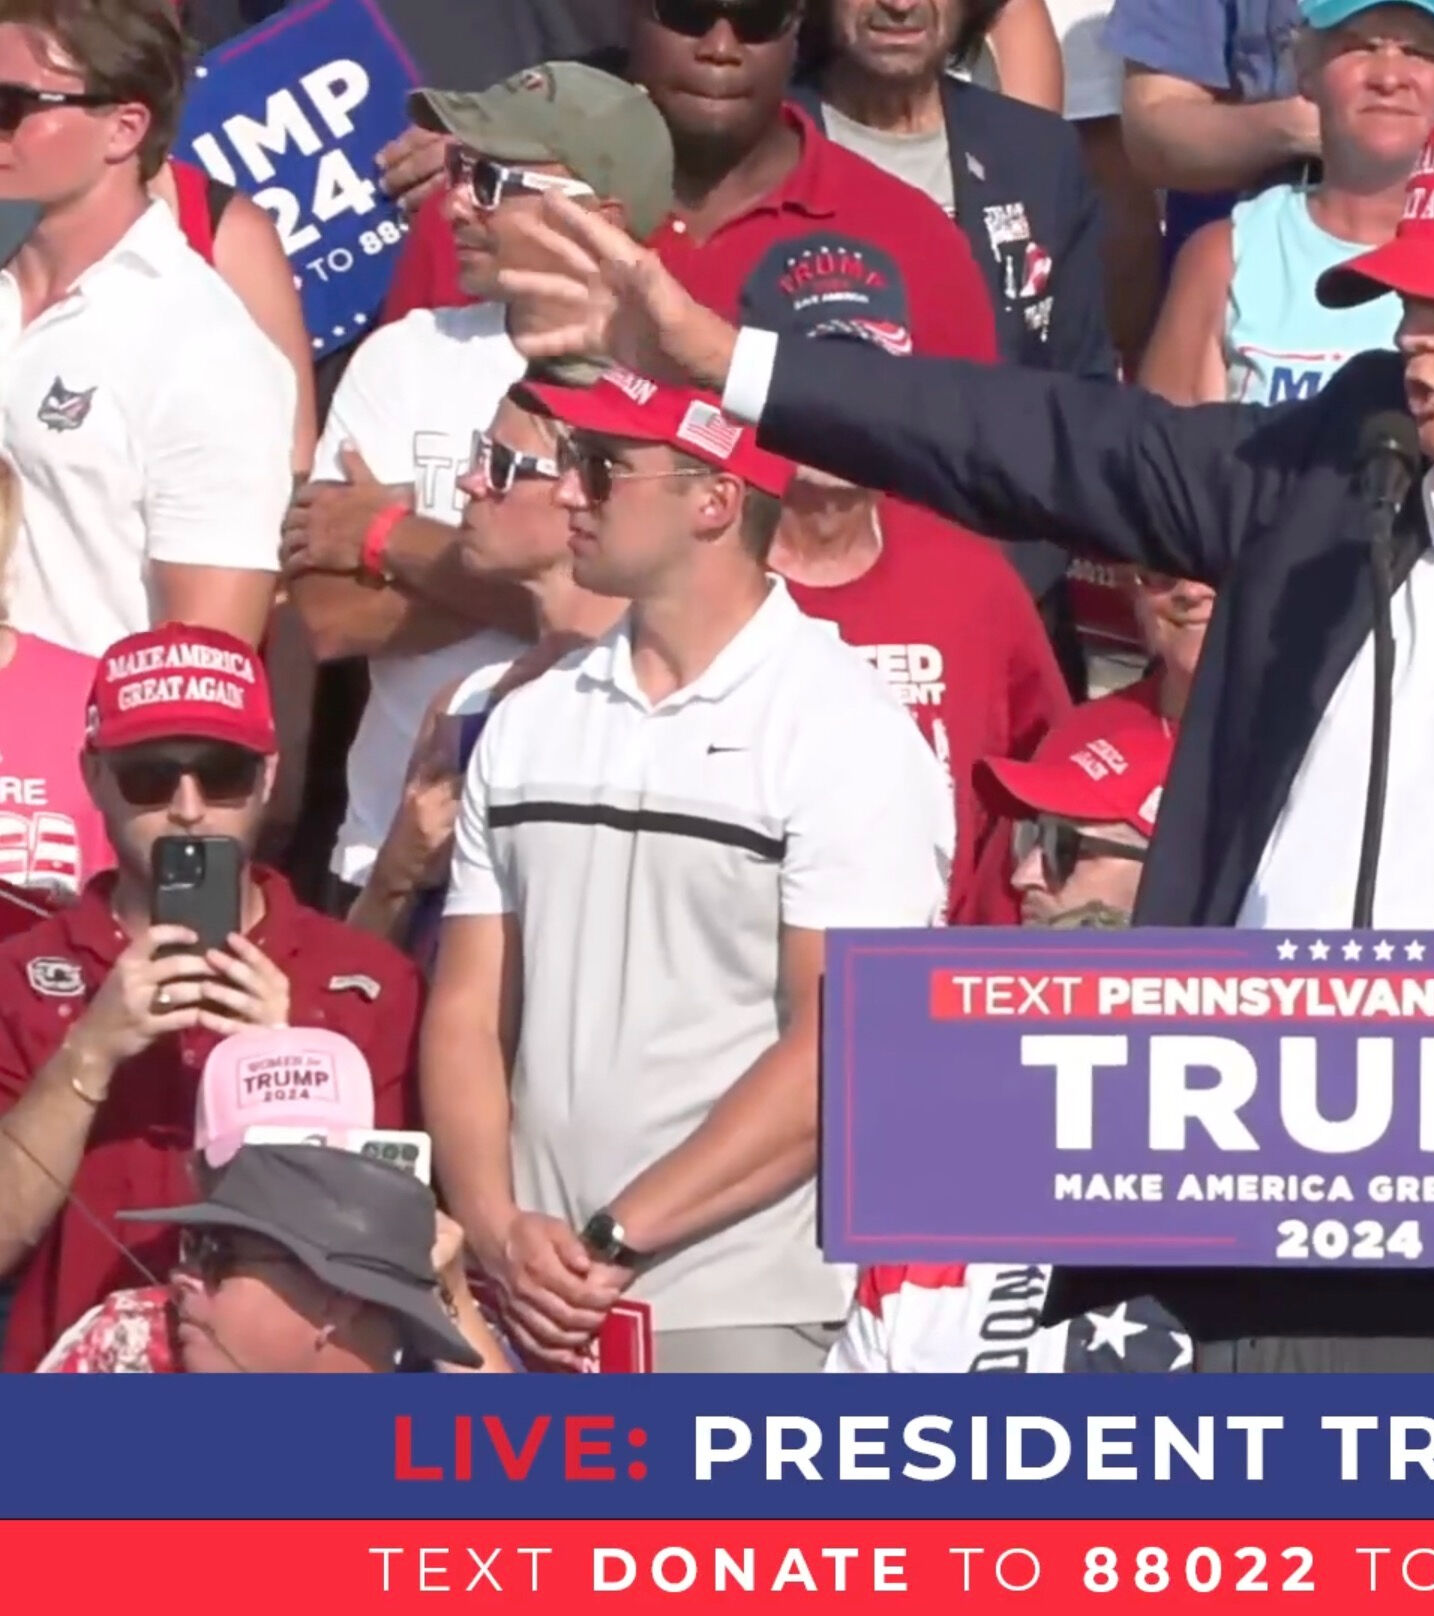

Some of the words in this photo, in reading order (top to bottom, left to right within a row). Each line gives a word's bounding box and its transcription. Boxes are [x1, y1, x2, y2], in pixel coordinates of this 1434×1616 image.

[306, 247, 353, 282] TO
[358, 219, 410, 255] 88
[779, 252, 888, 293] TRUMP
[105, 644, 165, 683] MAKE
[165, 642, 256, 685] AMERICA
[118, 675, 184, 711] GREAT
[184, 675, 245, 710] AGAIN
[953, 976, 1082, 1015] TEXT
[243, 1070, 330, 1095] TRUMP
[263, 1089, 309, 1103] 2024
[1054, 1173, 1163, 1202] MAKE
[1176, 1174, 1354, 1203] AMERICA
[1275, 1219, 1423, 1260] 2024
